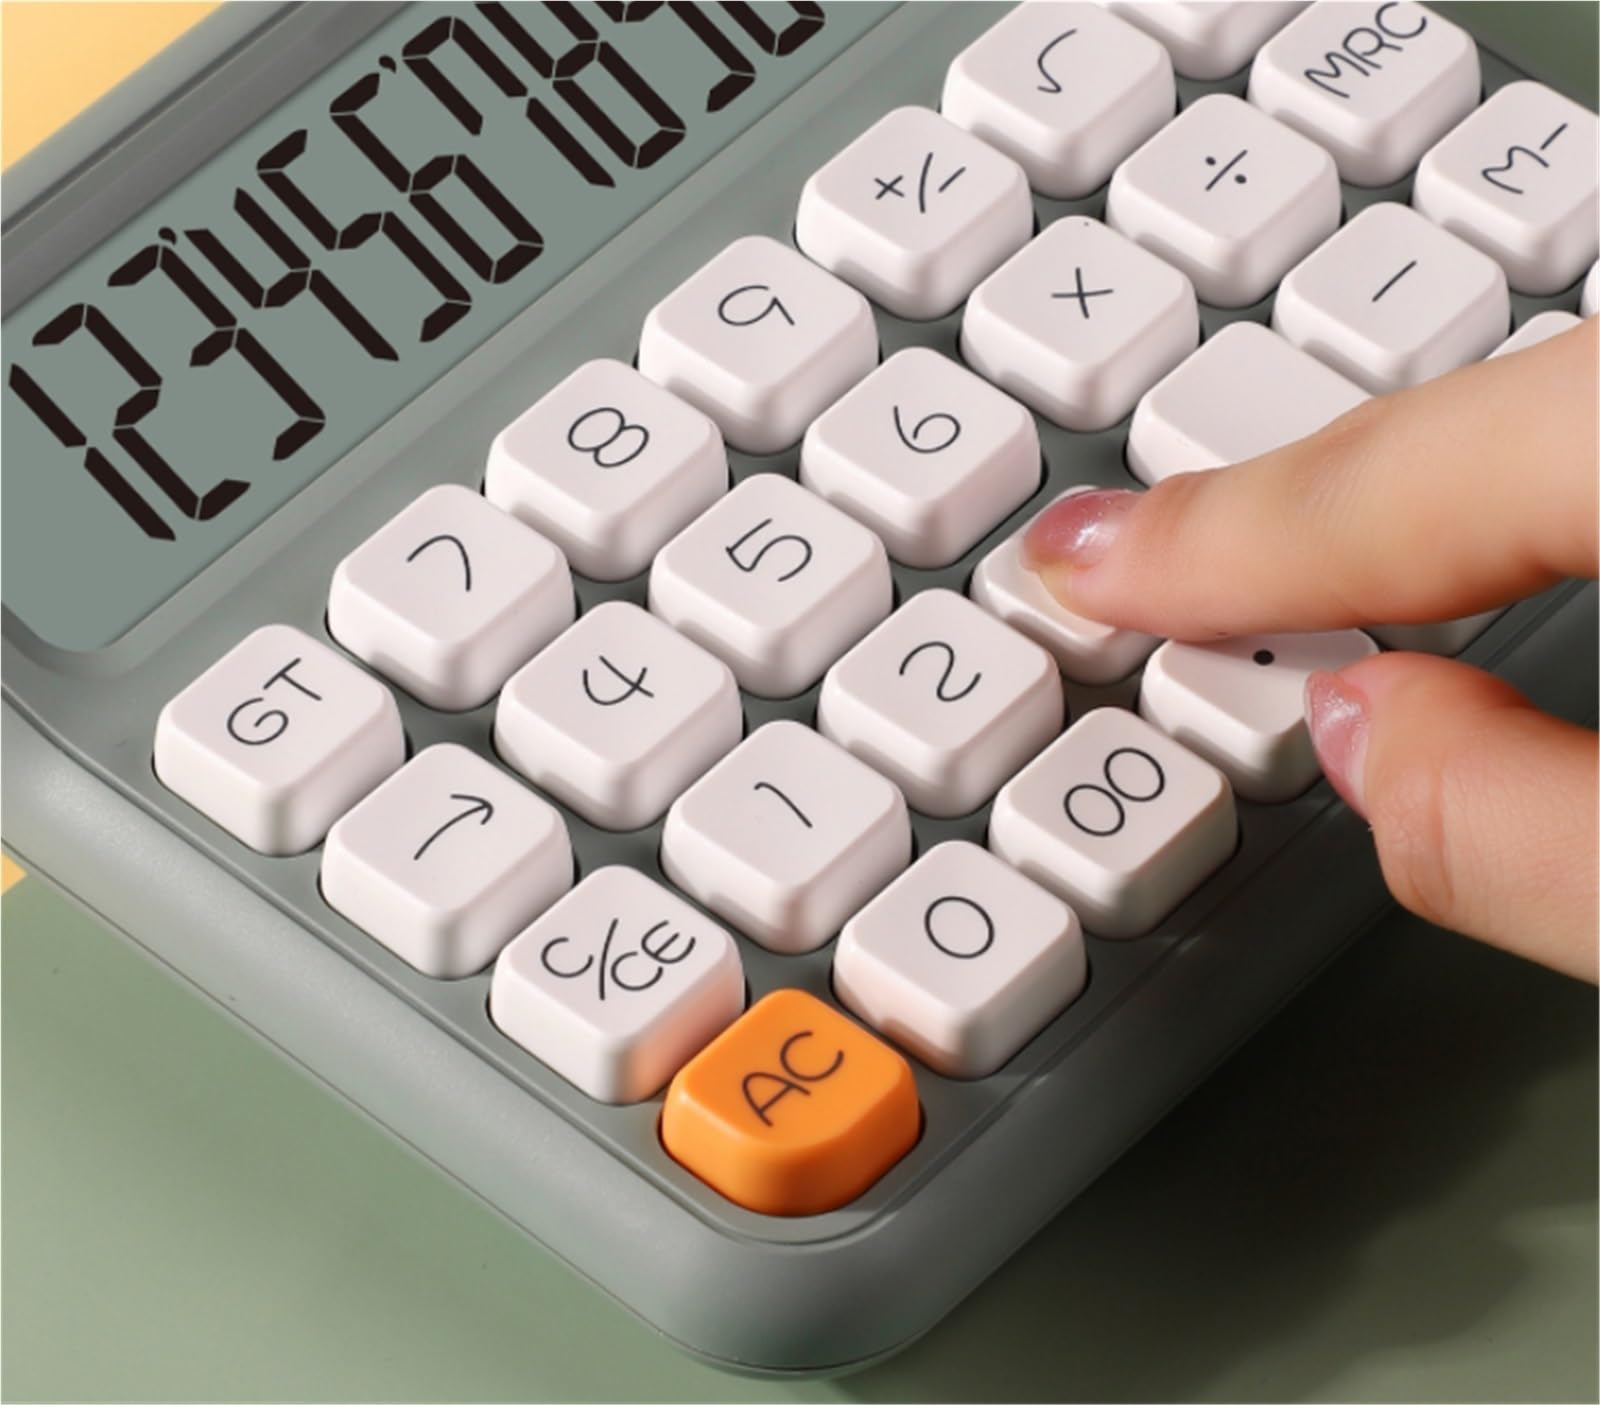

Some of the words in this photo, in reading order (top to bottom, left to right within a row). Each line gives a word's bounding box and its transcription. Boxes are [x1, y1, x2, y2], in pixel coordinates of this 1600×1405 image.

[1303, 1, 1428, 98] MRC
[1481, 122, 1569, 195] M-
[717, 284, 799, 328] 9
[566, 406, 650, 469] 8
[893, 405, 962, 455] 6
[406, 534, 473, 593] 7
[724, 518, 813, 583] 5
[225, 658, 323, 747] GT
[582, 655, 656, 707] 4
[898, 640, 983, 703] 2
[753, 781, 813, 829] 1
[1062, 747, 1166, 838] 00
[540, 917, 697, 1001] C/CE
[923, 895, 996, 960] 0
[741, 1030, 844, 1127] AC
